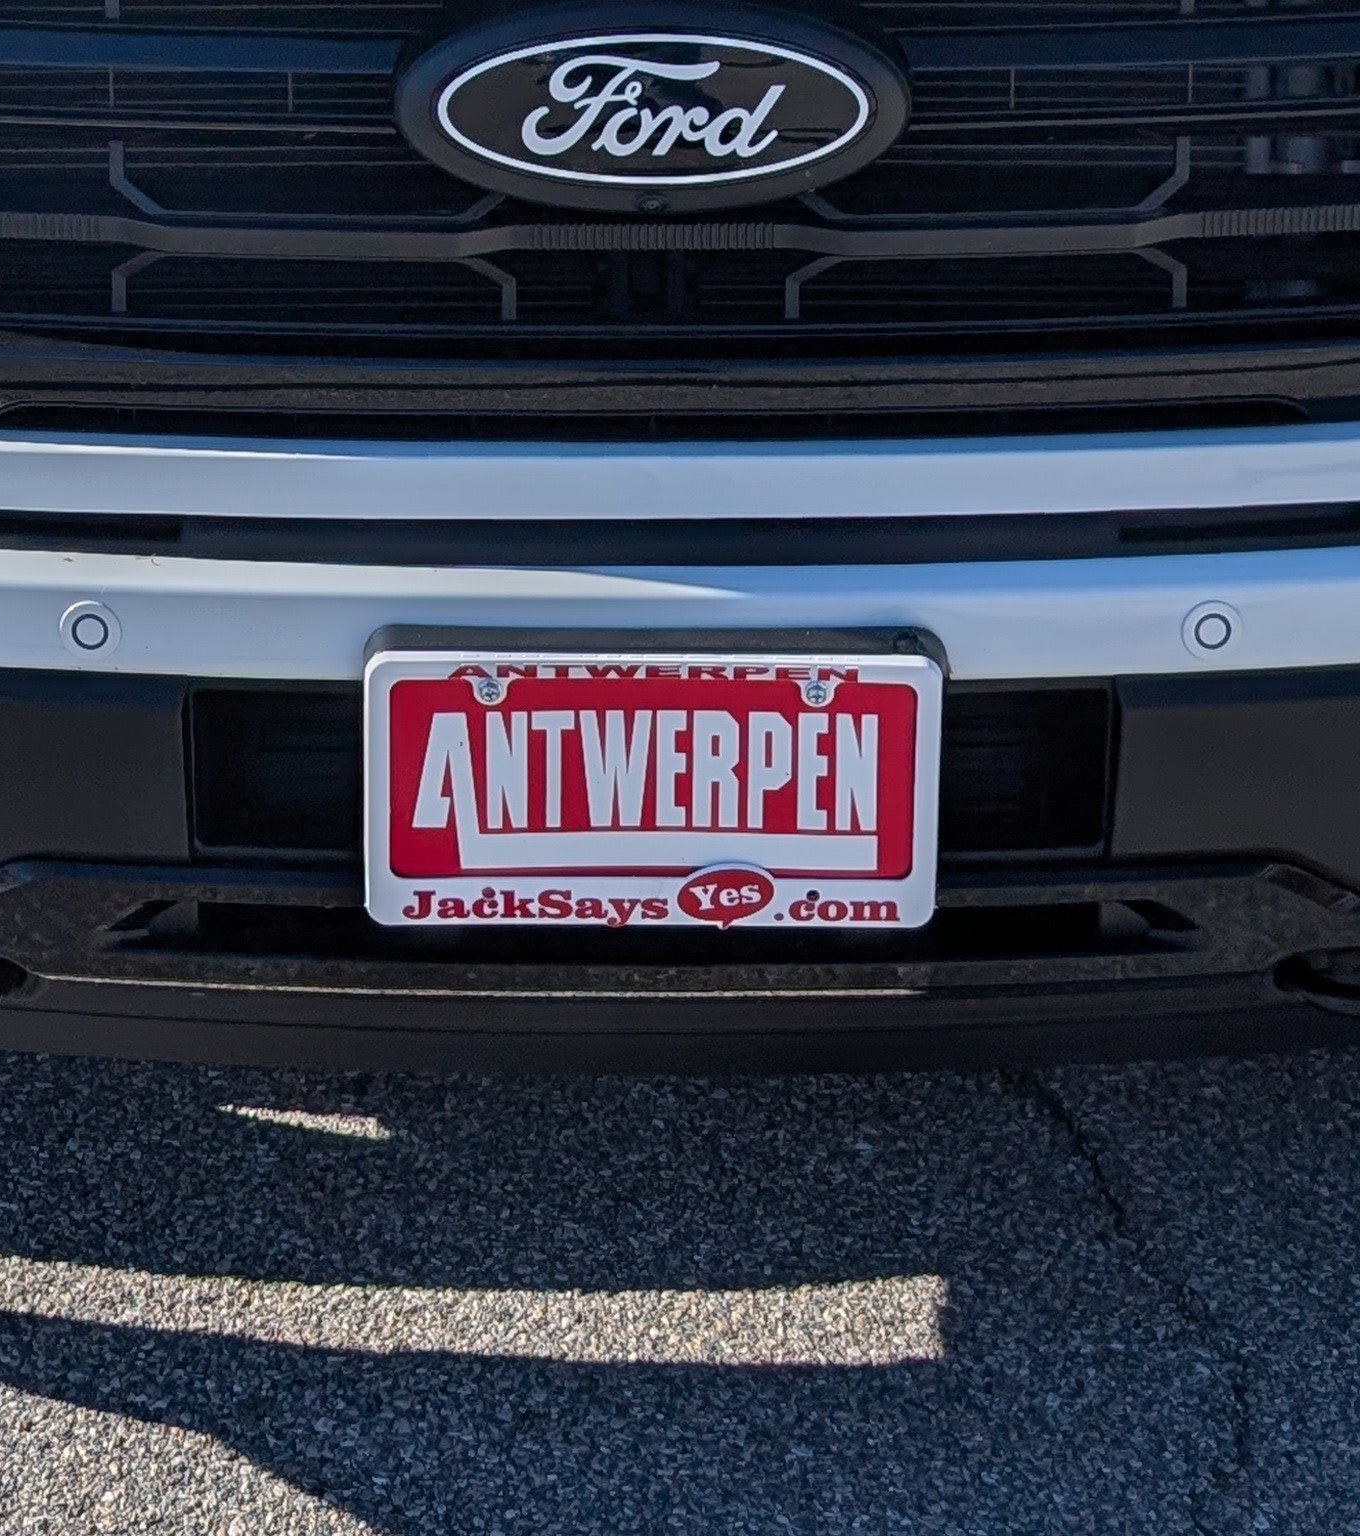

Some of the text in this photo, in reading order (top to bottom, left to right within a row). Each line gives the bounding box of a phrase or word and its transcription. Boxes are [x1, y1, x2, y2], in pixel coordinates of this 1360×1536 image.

[521, 54, 787, 158] Ford
[447, 664, 859, 683] ANTWERPEN
[411, 709, 879, 870] ANTWERPEN
